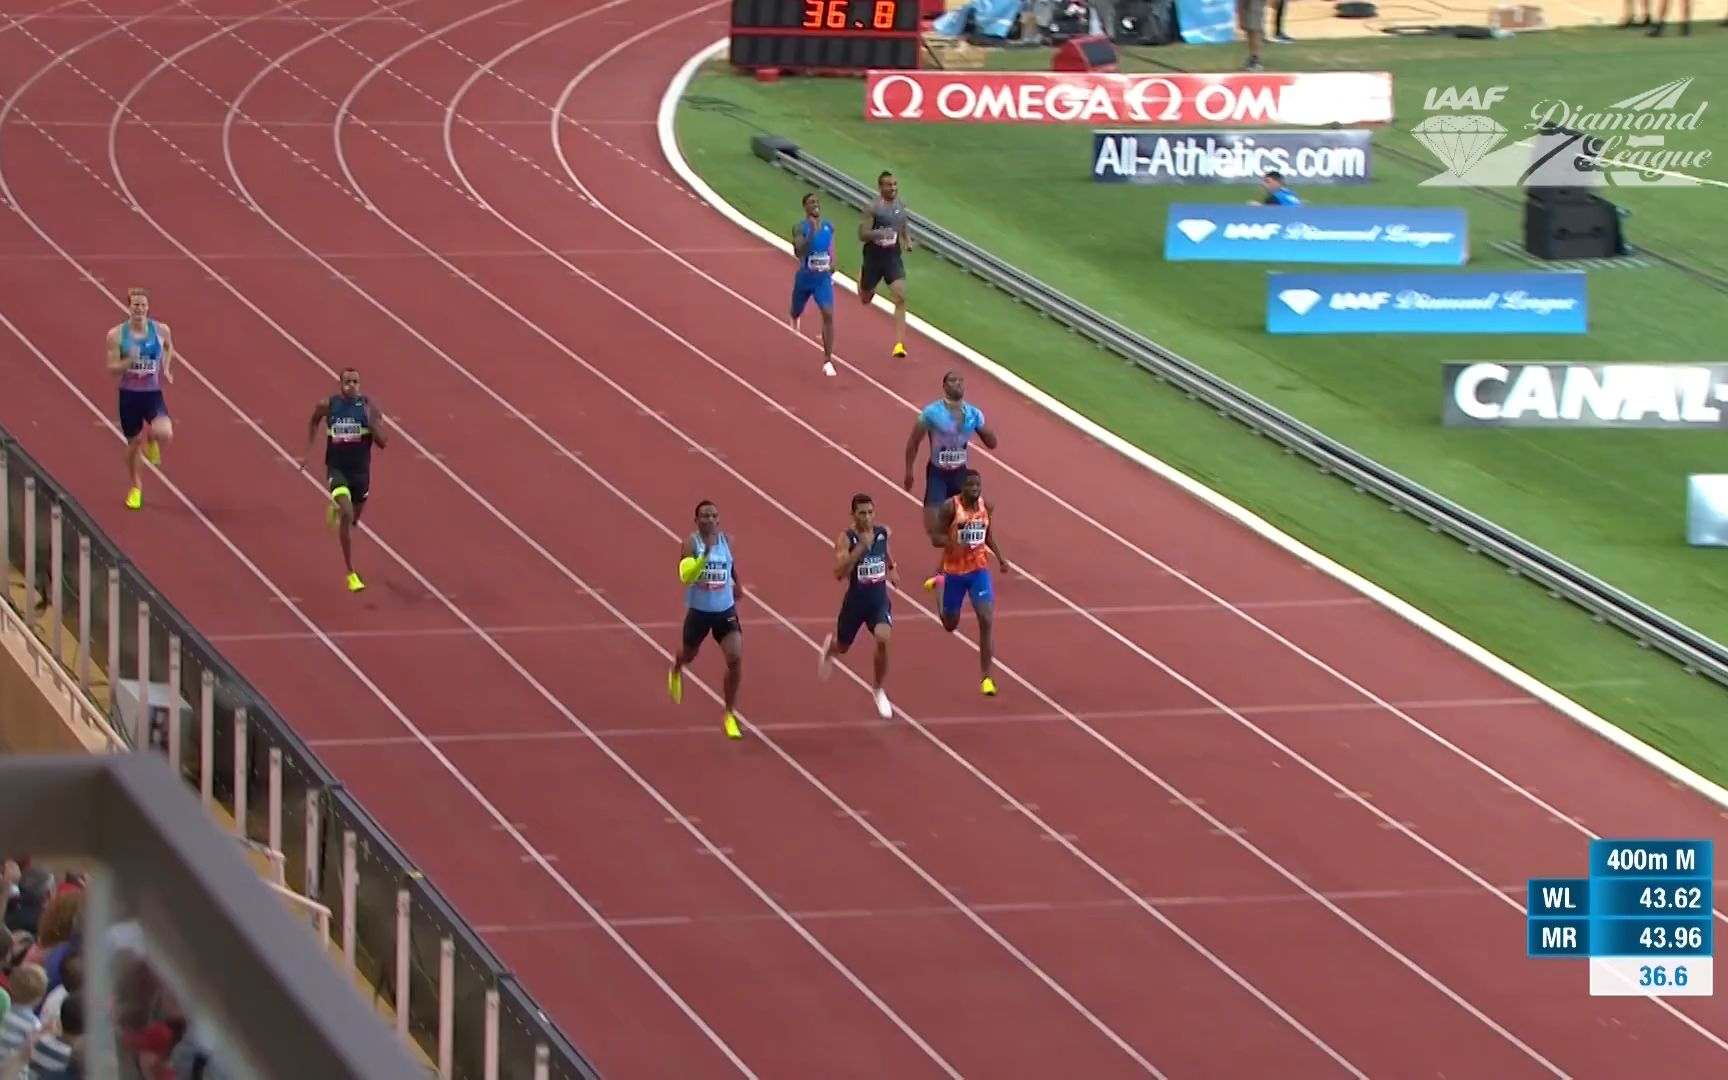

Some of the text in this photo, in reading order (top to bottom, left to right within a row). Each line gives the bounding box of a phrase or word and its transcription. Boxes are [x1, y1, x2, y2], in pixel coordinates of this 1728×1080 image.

[802, 0, 895, 29] 36.8
[937, 83, 1119, 120] OMEGA
[1095, 136, 1365, 178] All-Athletics.com
